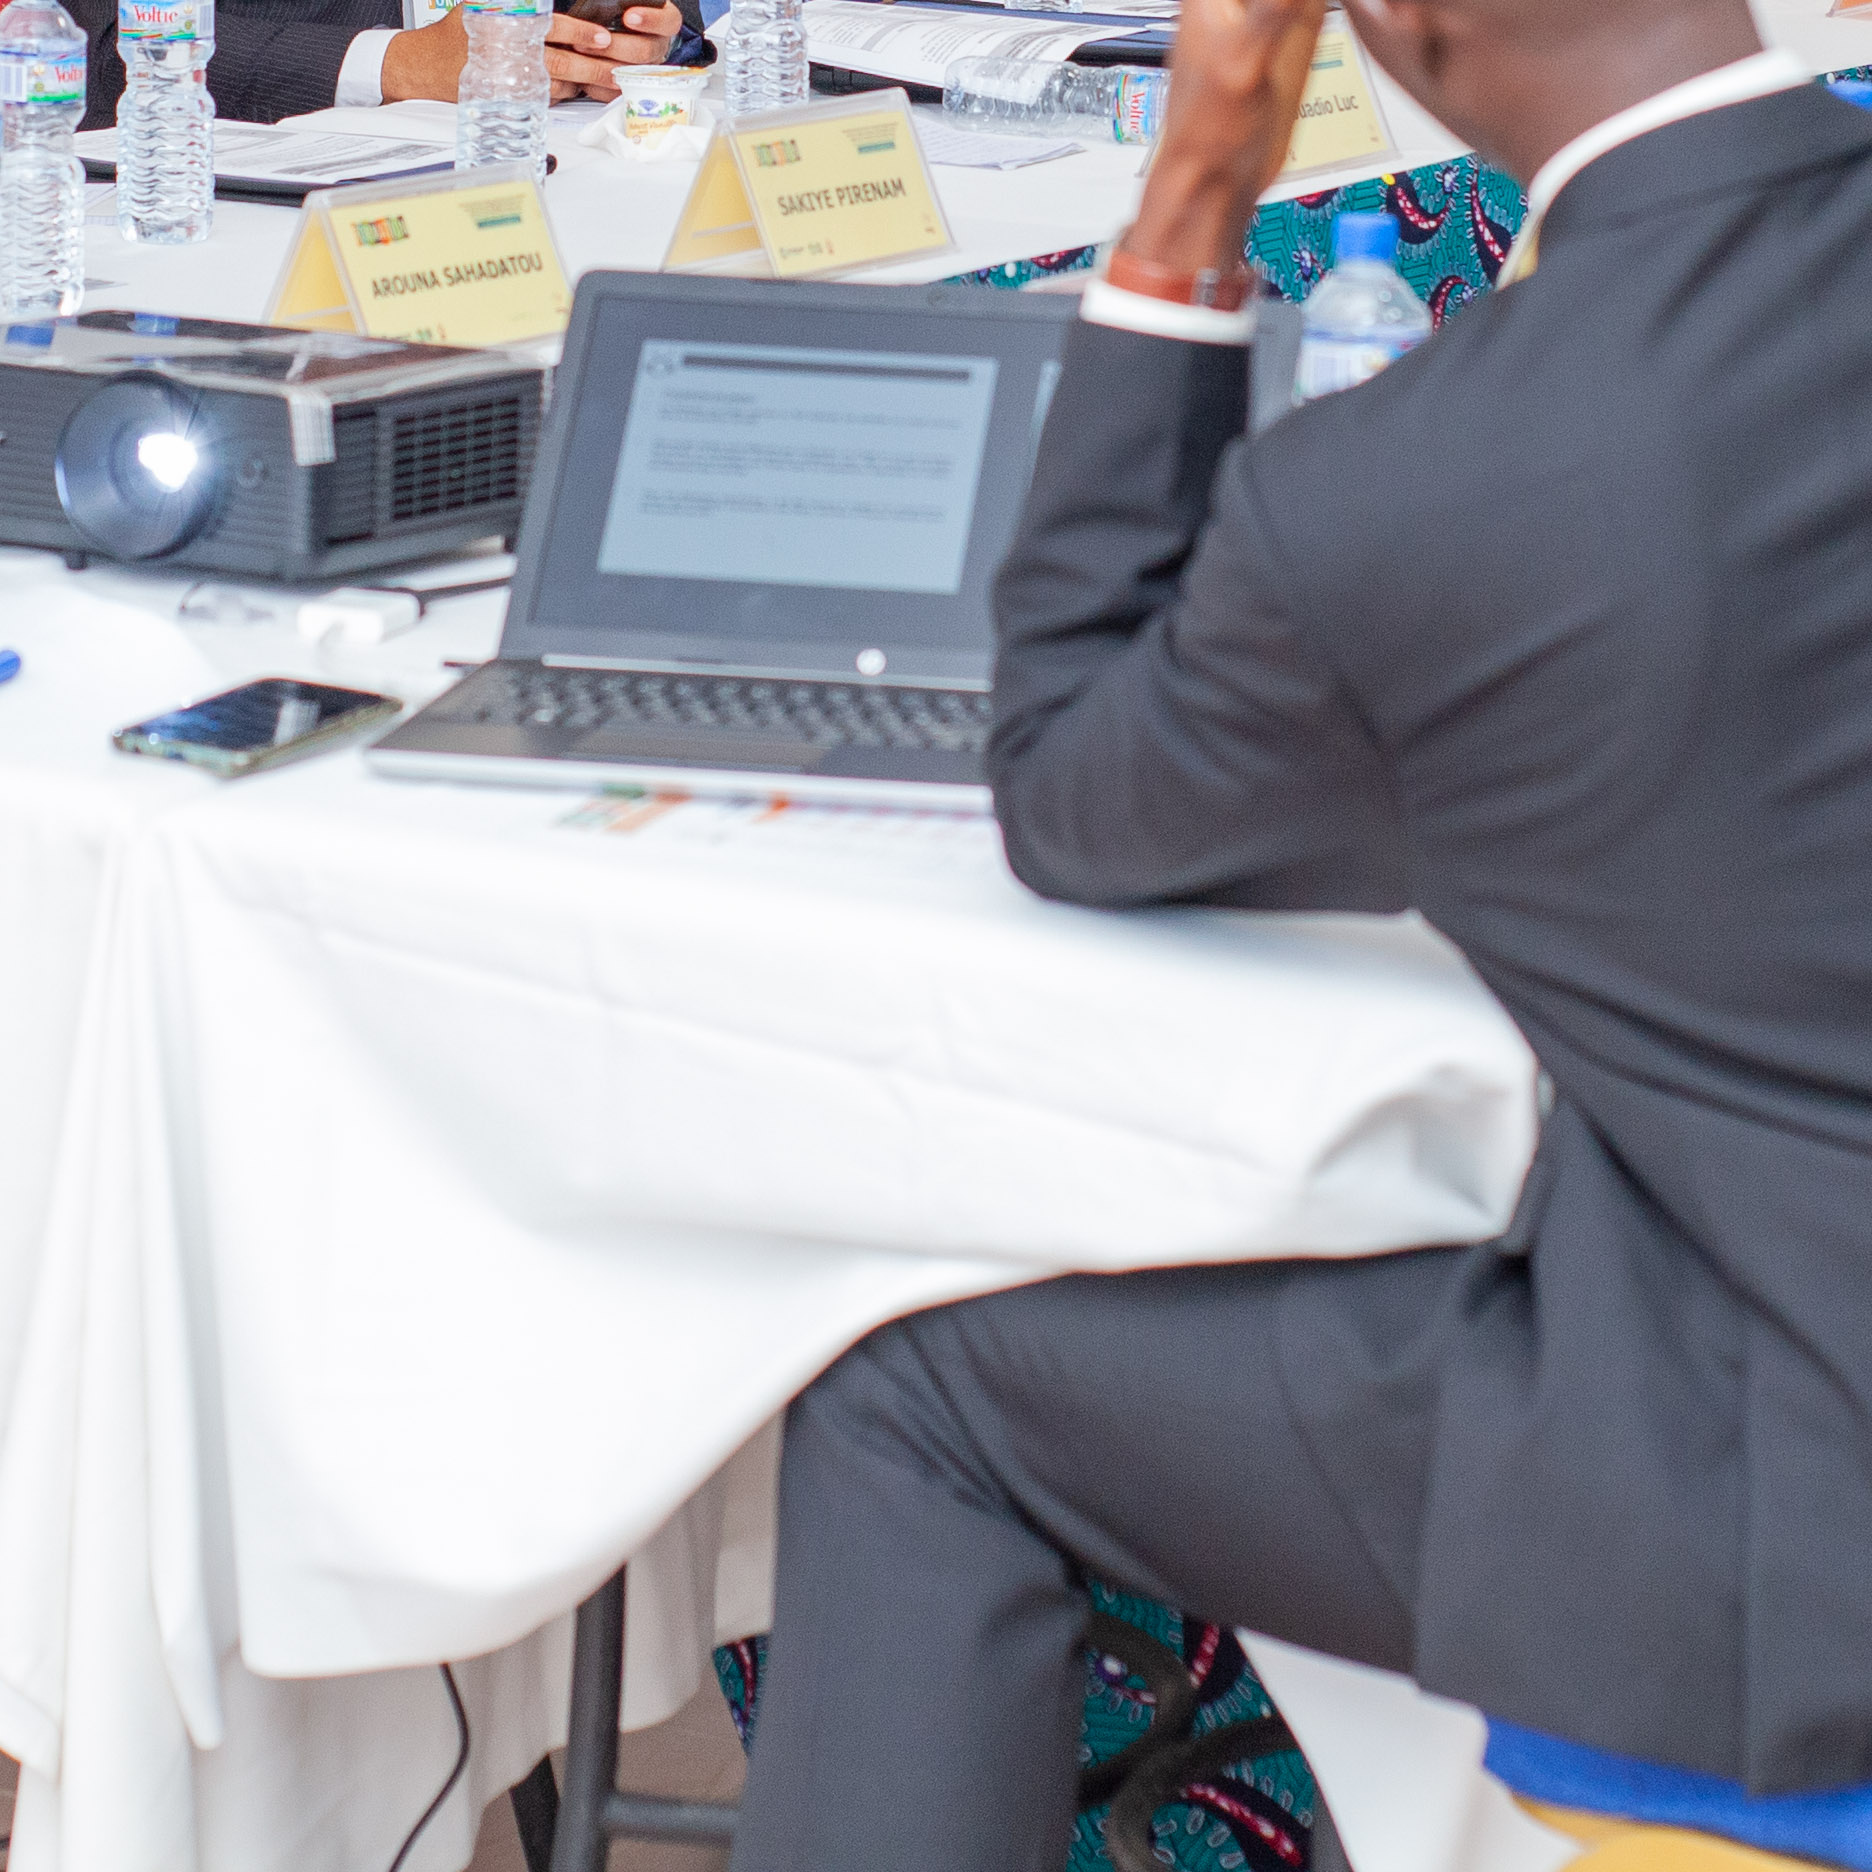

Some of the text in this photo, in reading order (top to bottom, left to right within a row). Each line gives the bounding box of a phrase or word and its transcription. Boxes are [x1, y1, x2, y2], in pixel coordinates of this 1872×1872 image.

[133, 5, 179, 23] Voltic
[1333, 94, 1359, 112] Luc
[777, 177, 906, 216] SAKIYE PIRENAM
[371, 251, 543, 298] AROUNA SAHADATOU
